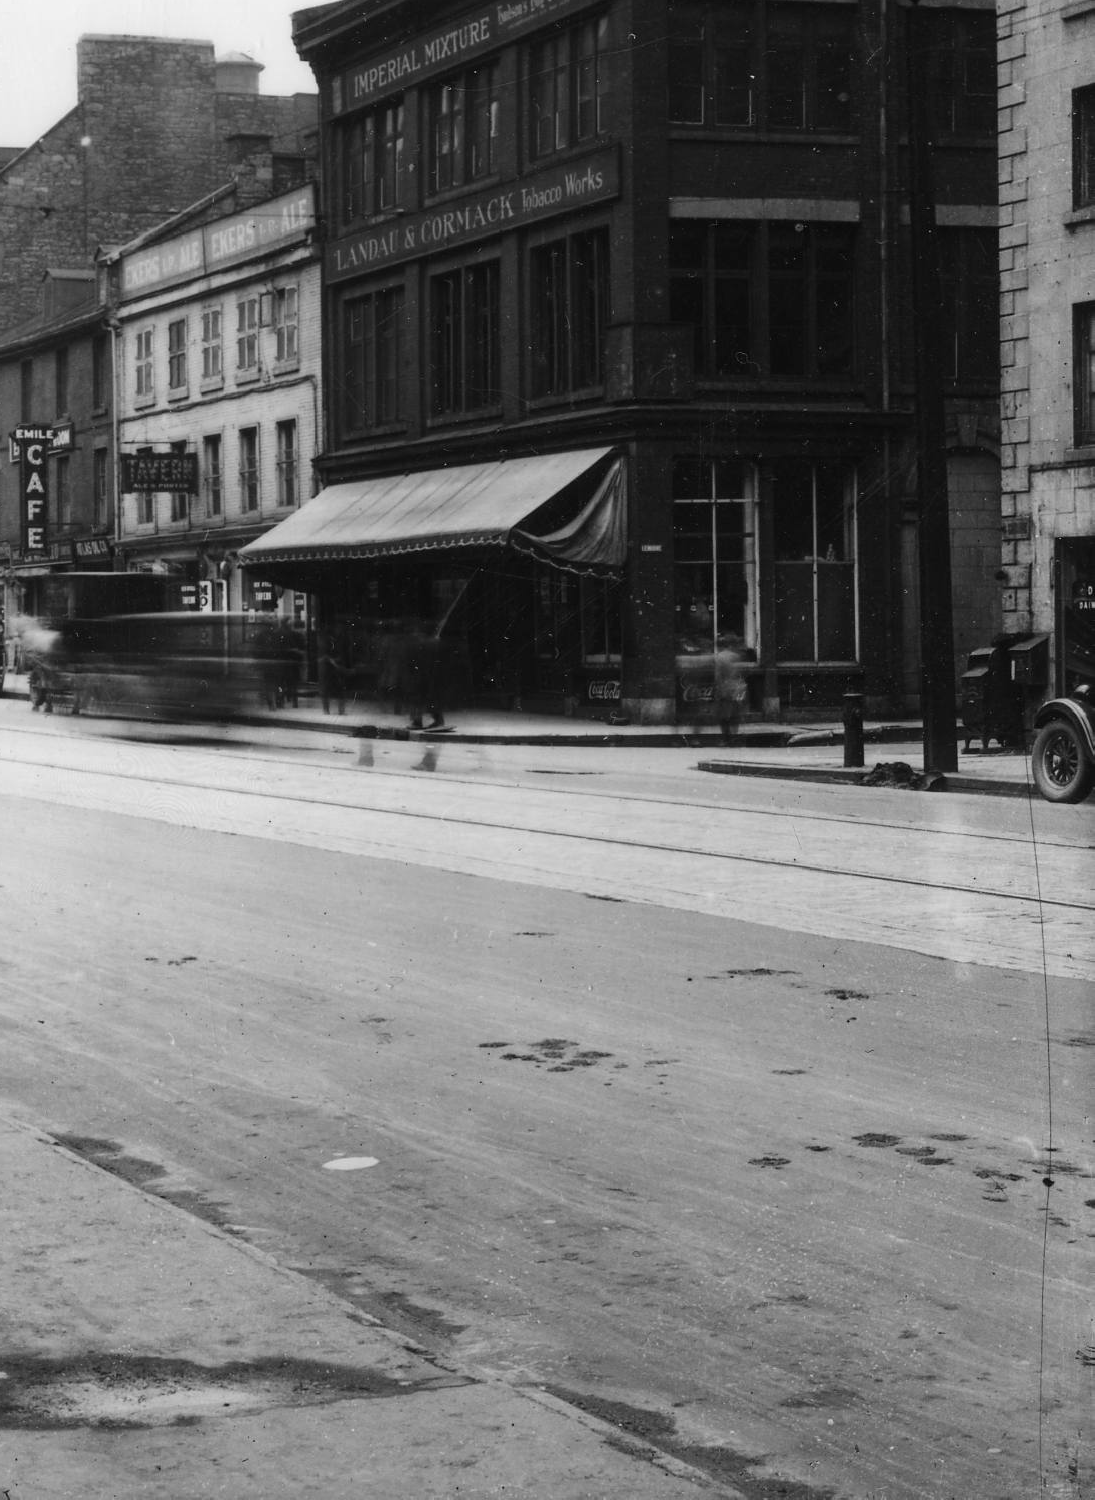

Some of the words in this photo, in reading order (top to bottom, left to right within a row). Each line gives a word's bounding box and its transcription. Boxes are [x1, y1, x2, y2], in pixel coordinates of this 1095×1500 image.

[354, 51, 421, 97] IMPERIAL
[425, 16, 490, 65] MIXTURE
[210, 219, 255, 258] EKERS
[281, 199, 308, 232] ALE
[335, 229, 399, 271] LANDAU
[404, 225, 417, 249] &
[420, 193, 515, 244] CORMACK
[521, 185, 562, 213] Tobacco
[564, 167, 603, 197] Works
[15, 429, 55, 440] EMILE
[26, 444, 45, 549] CAFE
[127, 459, 194, 482] TAVERN
